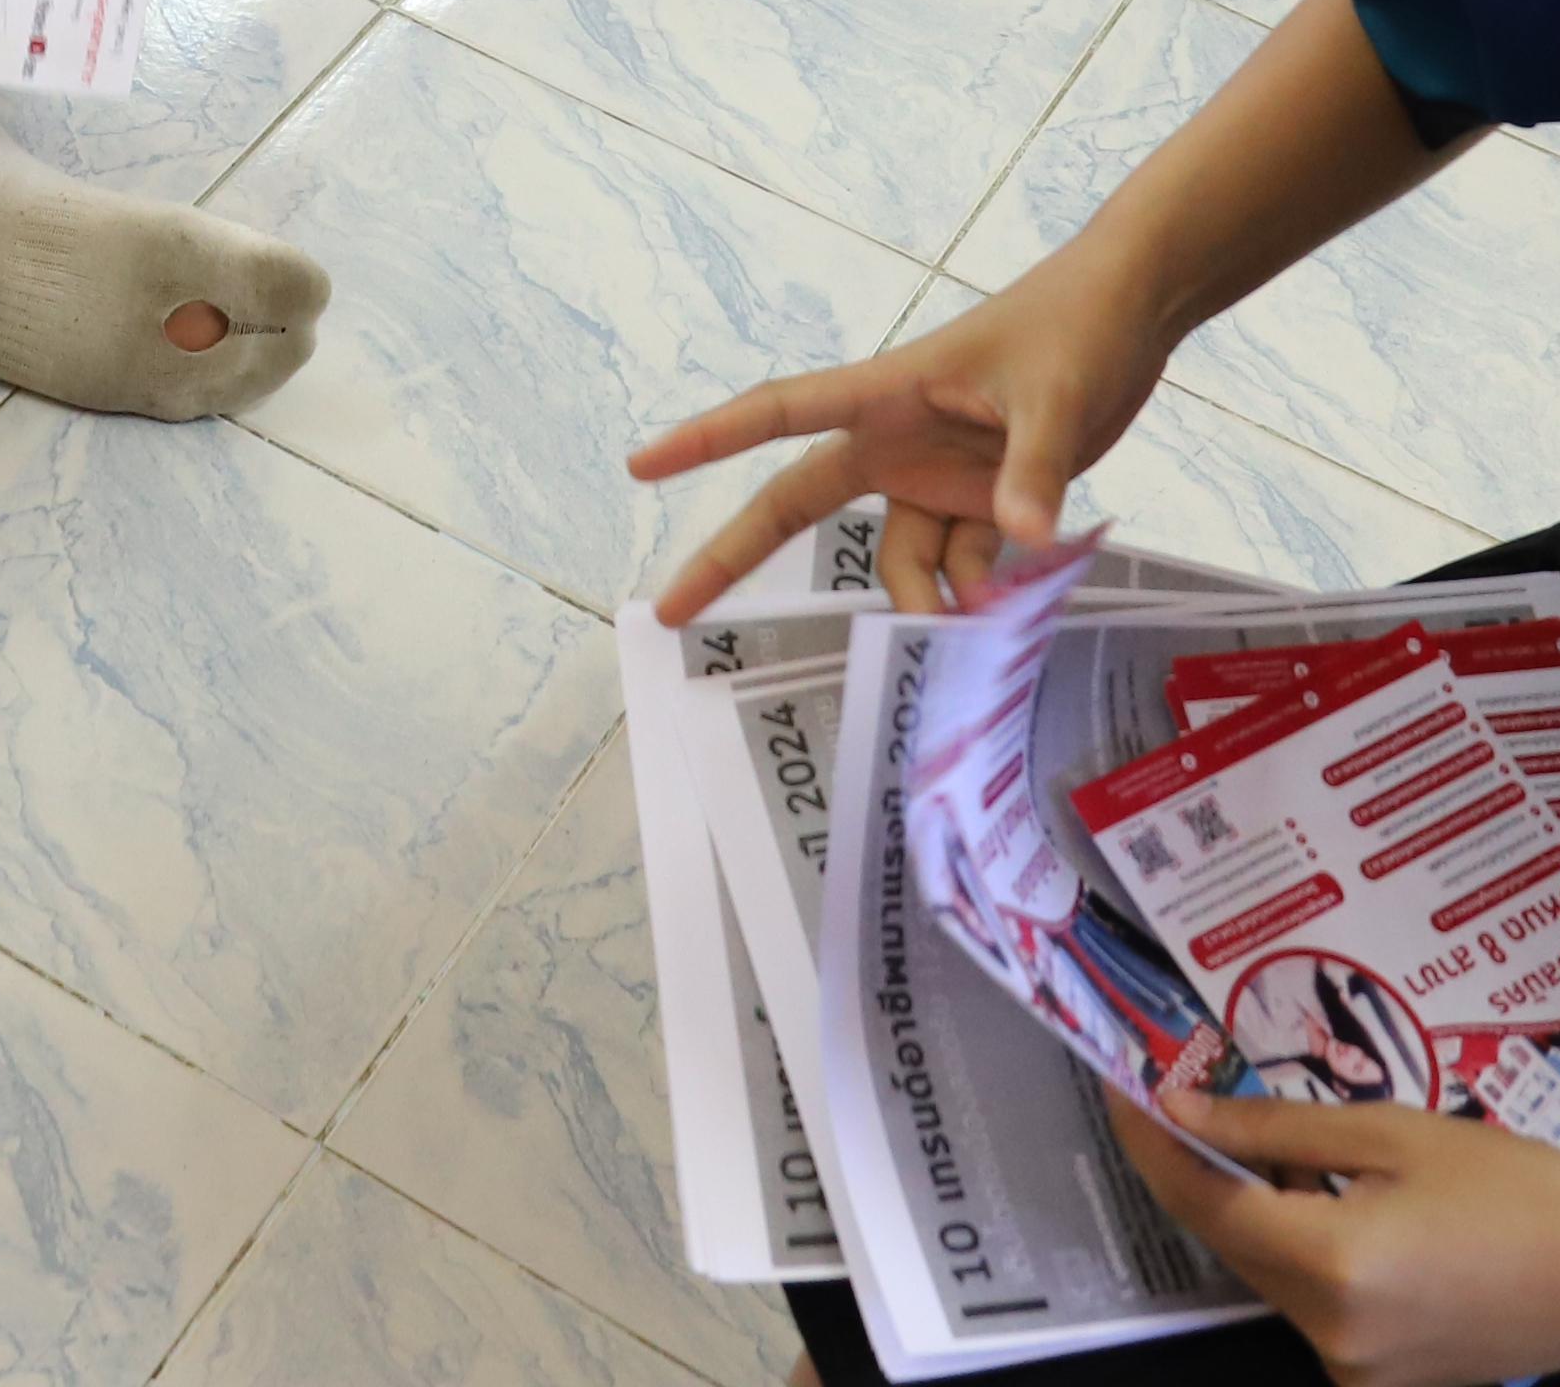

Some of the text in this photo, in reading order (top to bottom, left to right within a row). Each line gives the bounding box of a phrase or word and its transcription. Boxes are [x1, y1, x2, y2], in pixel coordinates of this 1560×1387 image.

[830, 520, 877, 591] 024
[888, 637, 932, 765] 2024
[759, 698, 829, 818] 2024
[1401, 939, 1478, 1003] สาขา
[1475, 927, 1507, 968] 8
[937, 1221, 994, 1285] 10
